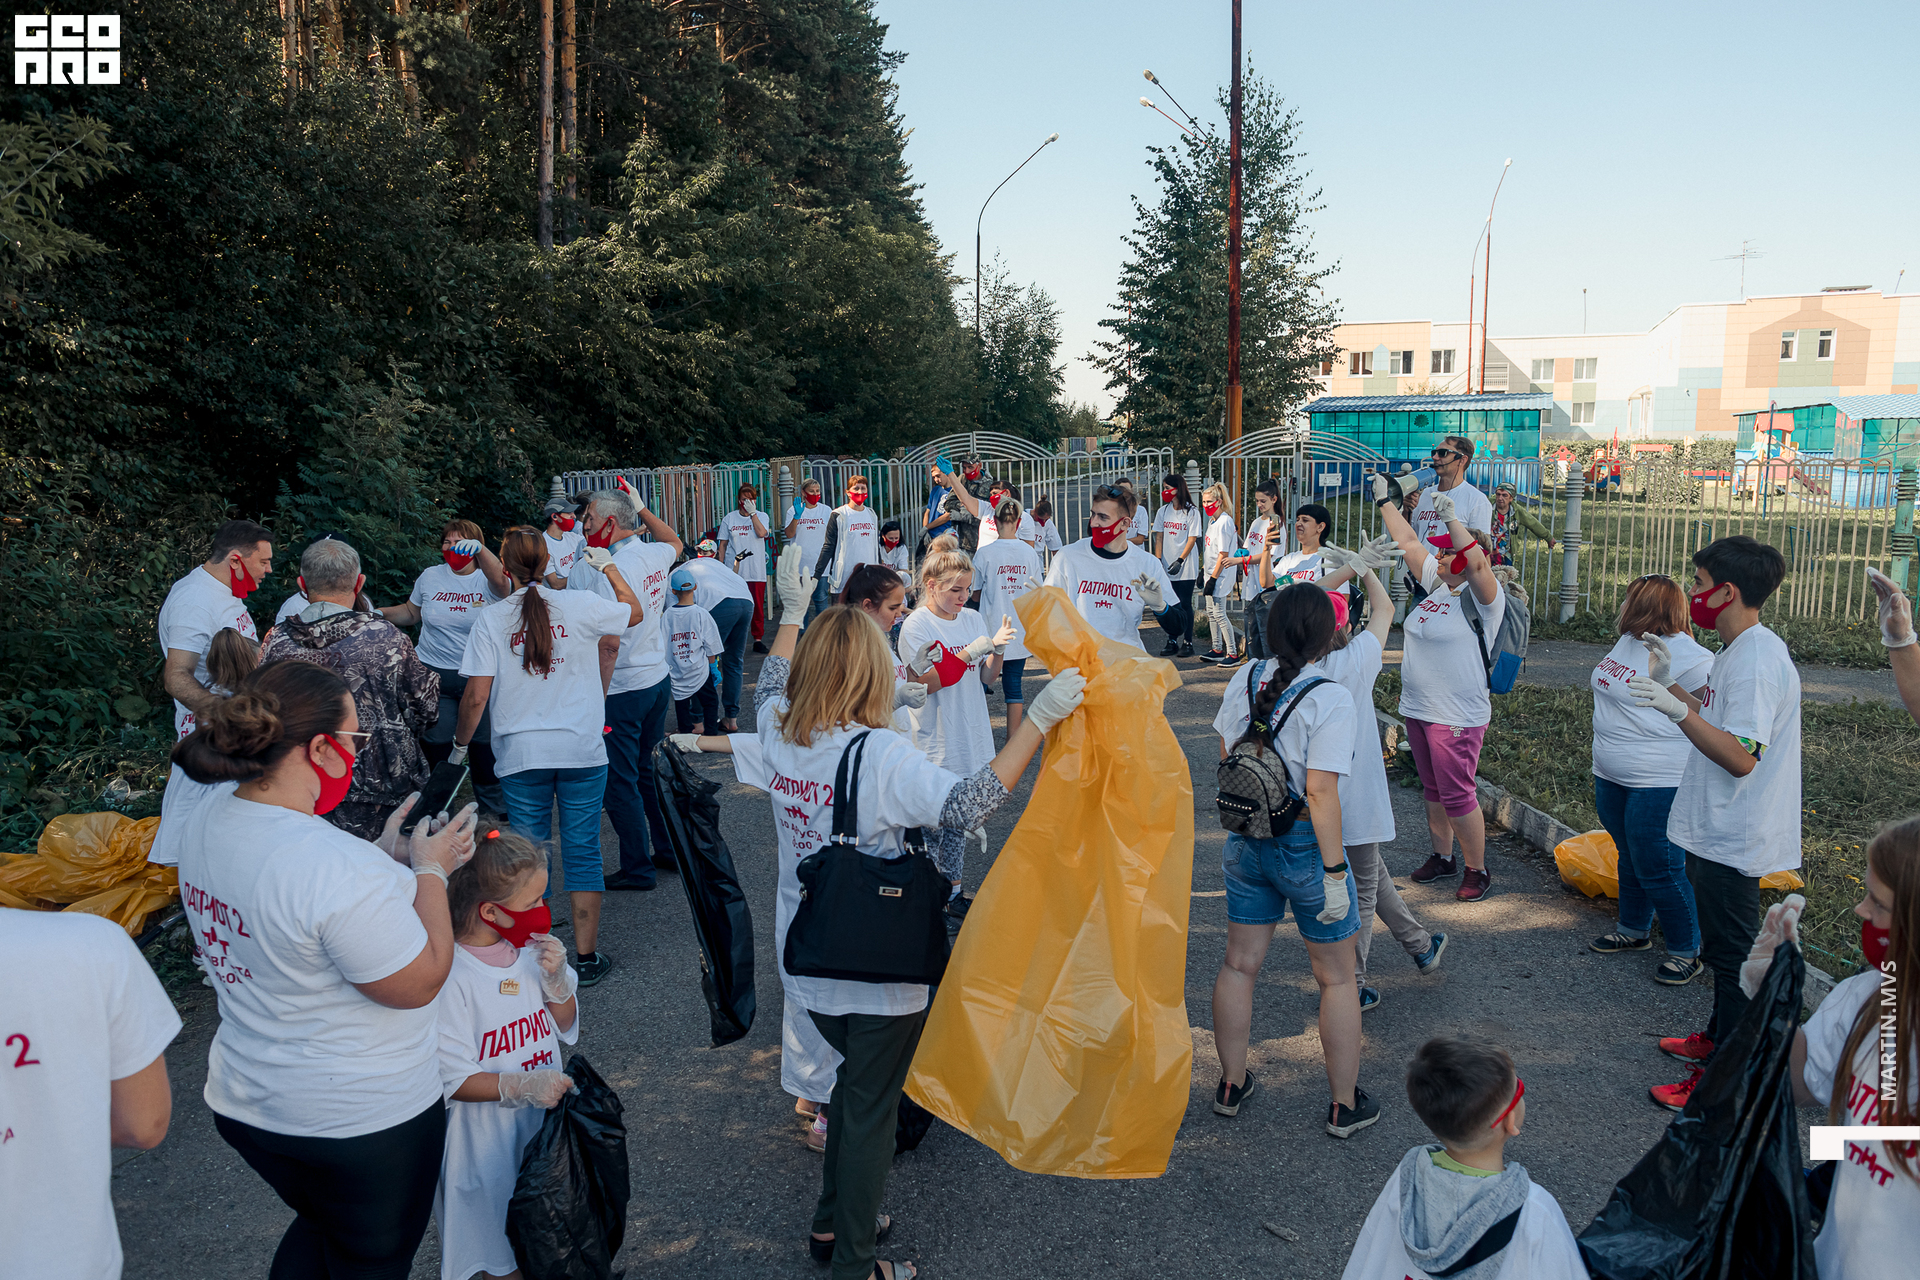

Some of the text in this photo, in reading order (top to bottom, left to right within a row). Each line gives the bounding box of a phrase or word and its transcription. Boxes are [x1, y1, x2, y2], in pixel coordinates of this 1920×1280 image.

[1309, 570, 1315, 582] 2
[431, 591, 485, 604] ПАТРИОТ 2
[1077, 580, 1133, 601] ПАТРИОТ 2
[1094, 600, 1113, 609] ТНТ
[1441, 603, 1450, 615] 2
[557, 624, 569, 638] 2
[691, 631, 697, 640] 2
[1625, 669, 1637, 683] 2
[769, 771, 834, 806] ПАТРИОТ 2
[184, 881, 251, 938] ПАТРИОТ 2
[478, 1008, 551, 1062] ПАТРИО
[6, 1033, 41, 1068] 2
[521, 1049, 553, 1072] ТНТ
[1848, 1141, 1895, 1188] ТНТ
